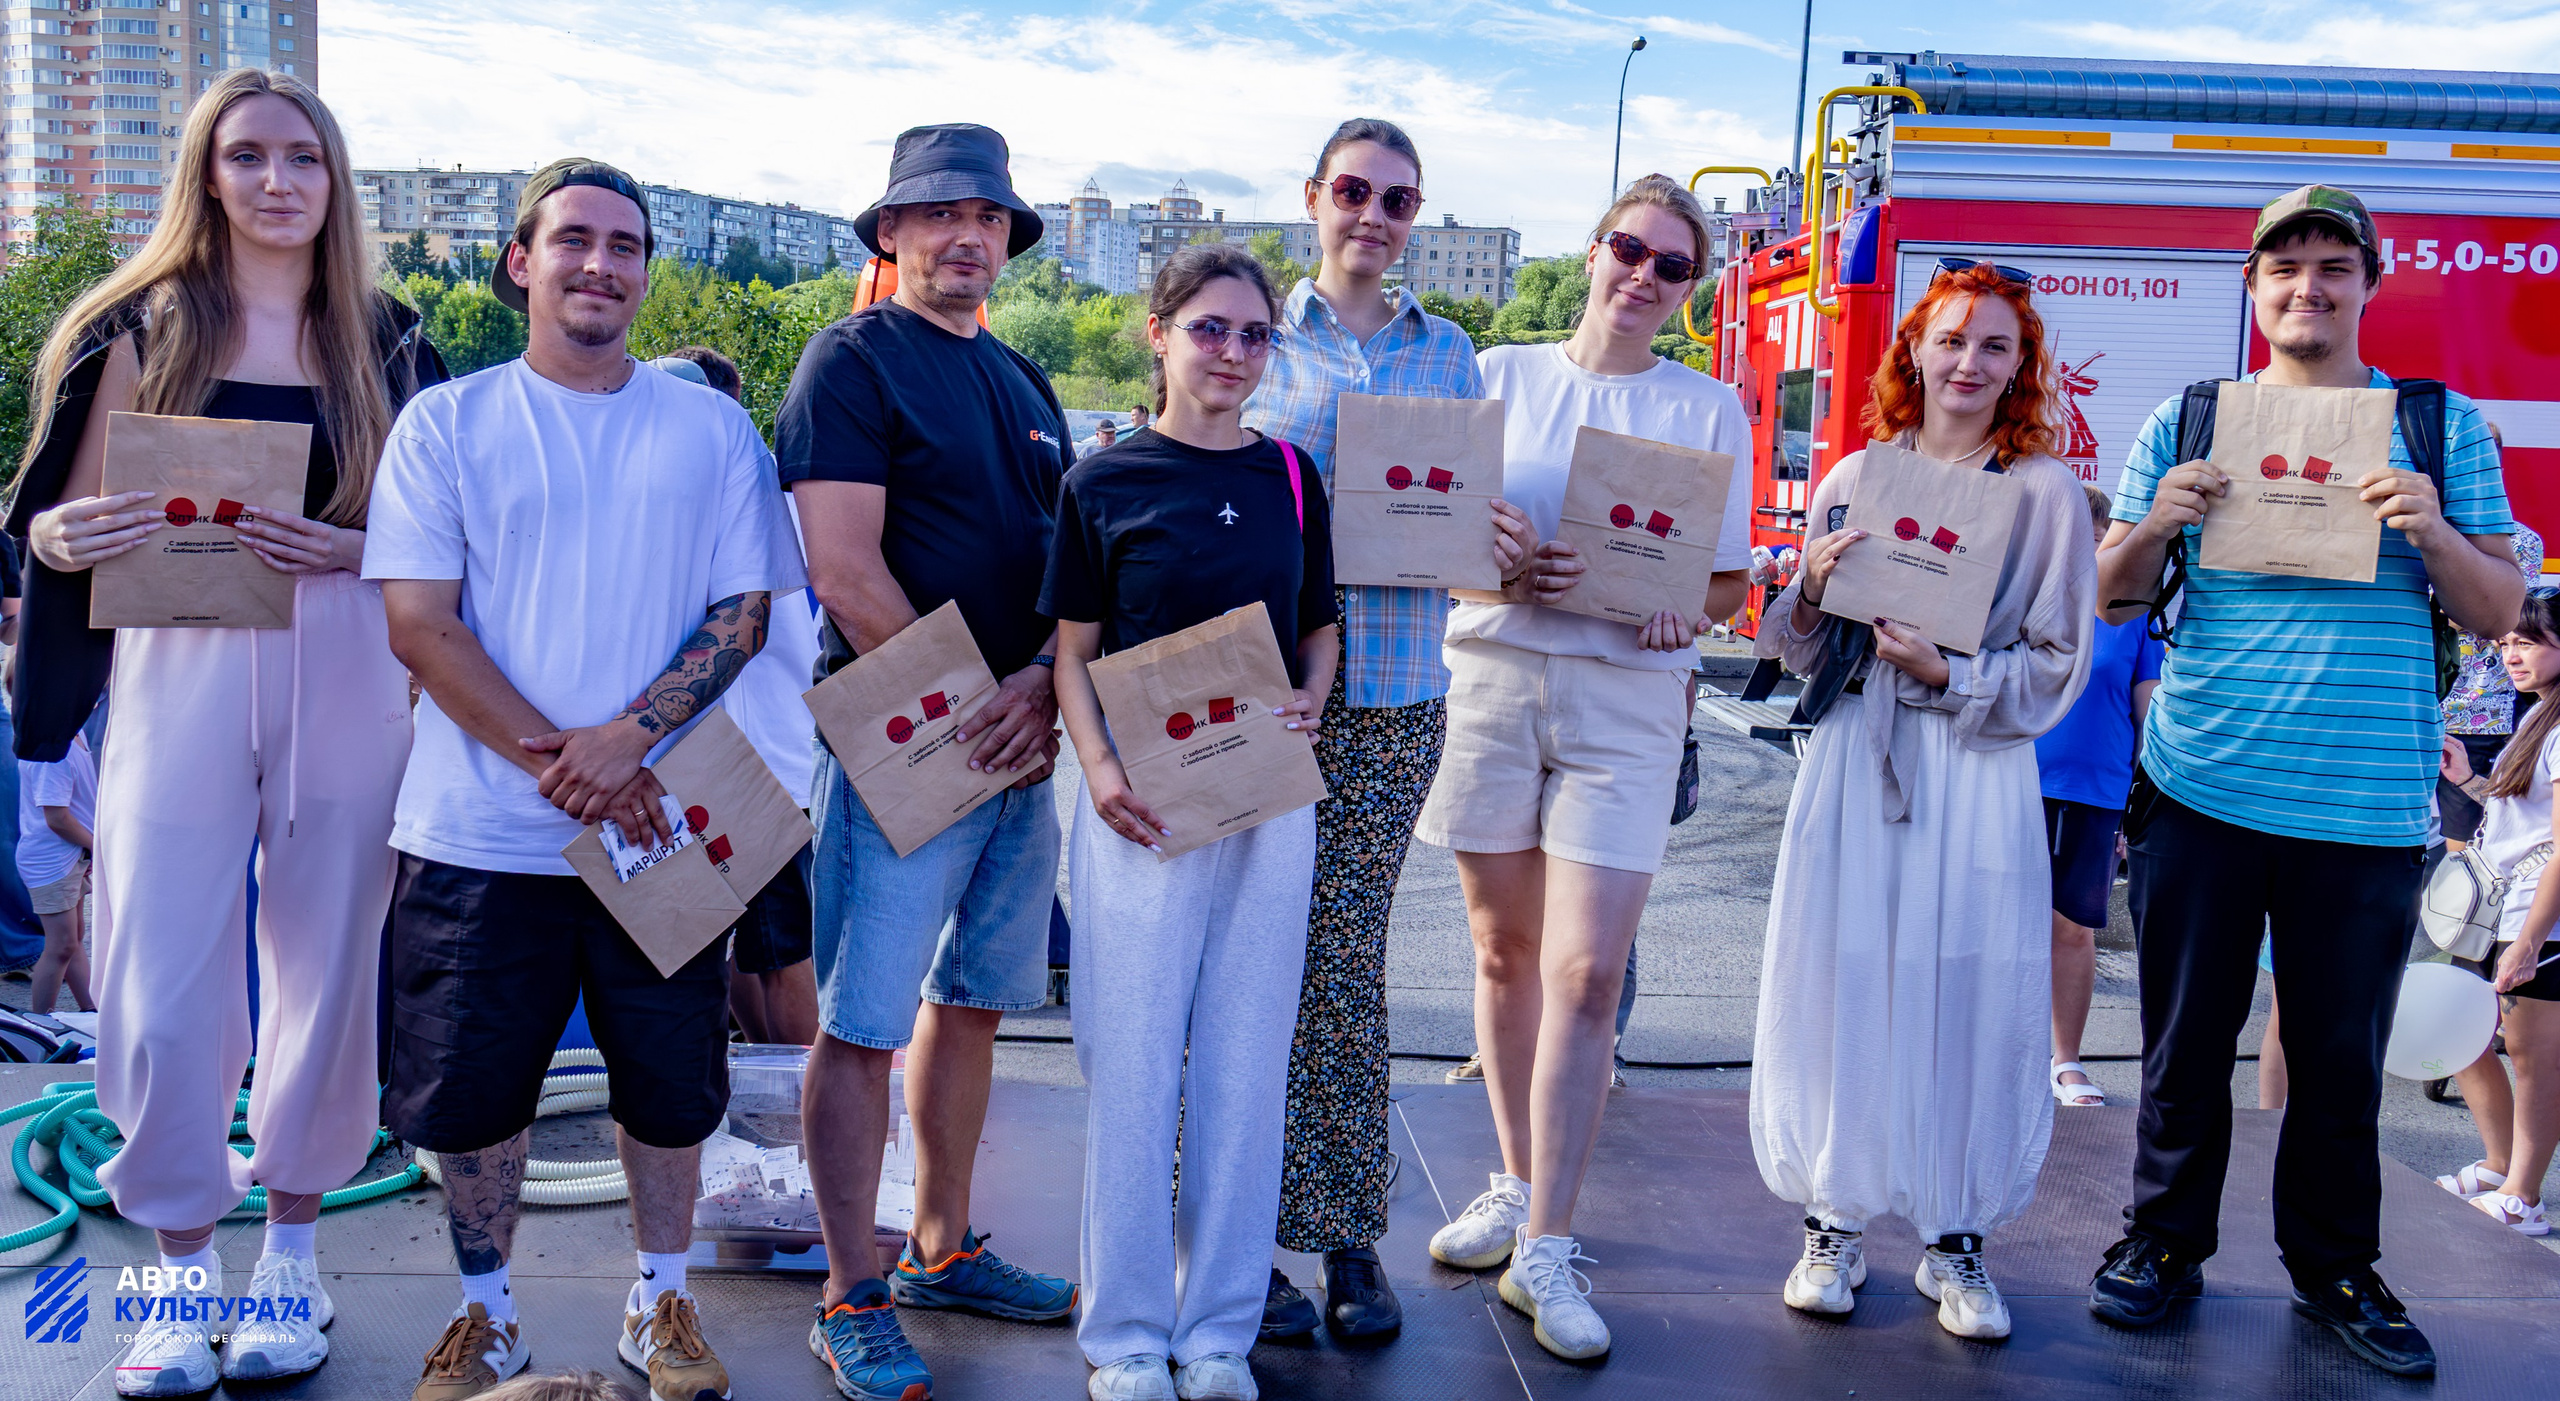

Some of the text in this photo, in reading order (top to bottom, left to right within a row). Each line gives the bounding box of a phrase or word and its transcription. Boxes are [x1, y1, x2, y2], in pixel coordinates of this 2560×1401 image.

[1766, 314, 1782, 345] АЦ
[2261, 466, 2342, 482] Оптик Центр
[1386, 477, 1463, 490] Оптик Центр
[166, 512, 210, 523] Оптик
[1610, 514, 1681, 538] Оптик Центр
[1615, 540, 1637, 548] заботой
[1895, 527, 1966, 554] Оптик Центр
[1610, 546, 1636, 555] любовью
[1898, 552, 1920, 562] заботой
[1892, 557, 1918, 567] любовью
[890, 694, 960, 743] Оптик Центр
[1168, 703, 1248, 738] Оптик Центр
[913, 740, 935, 757] заботой
[914, 746, 938, 765] любовью
[1189, 744, 1213, 758] заботой
[1187, 752, 1215, 766] любовью
[626, 836, 684, 880] МАРШРУТ
